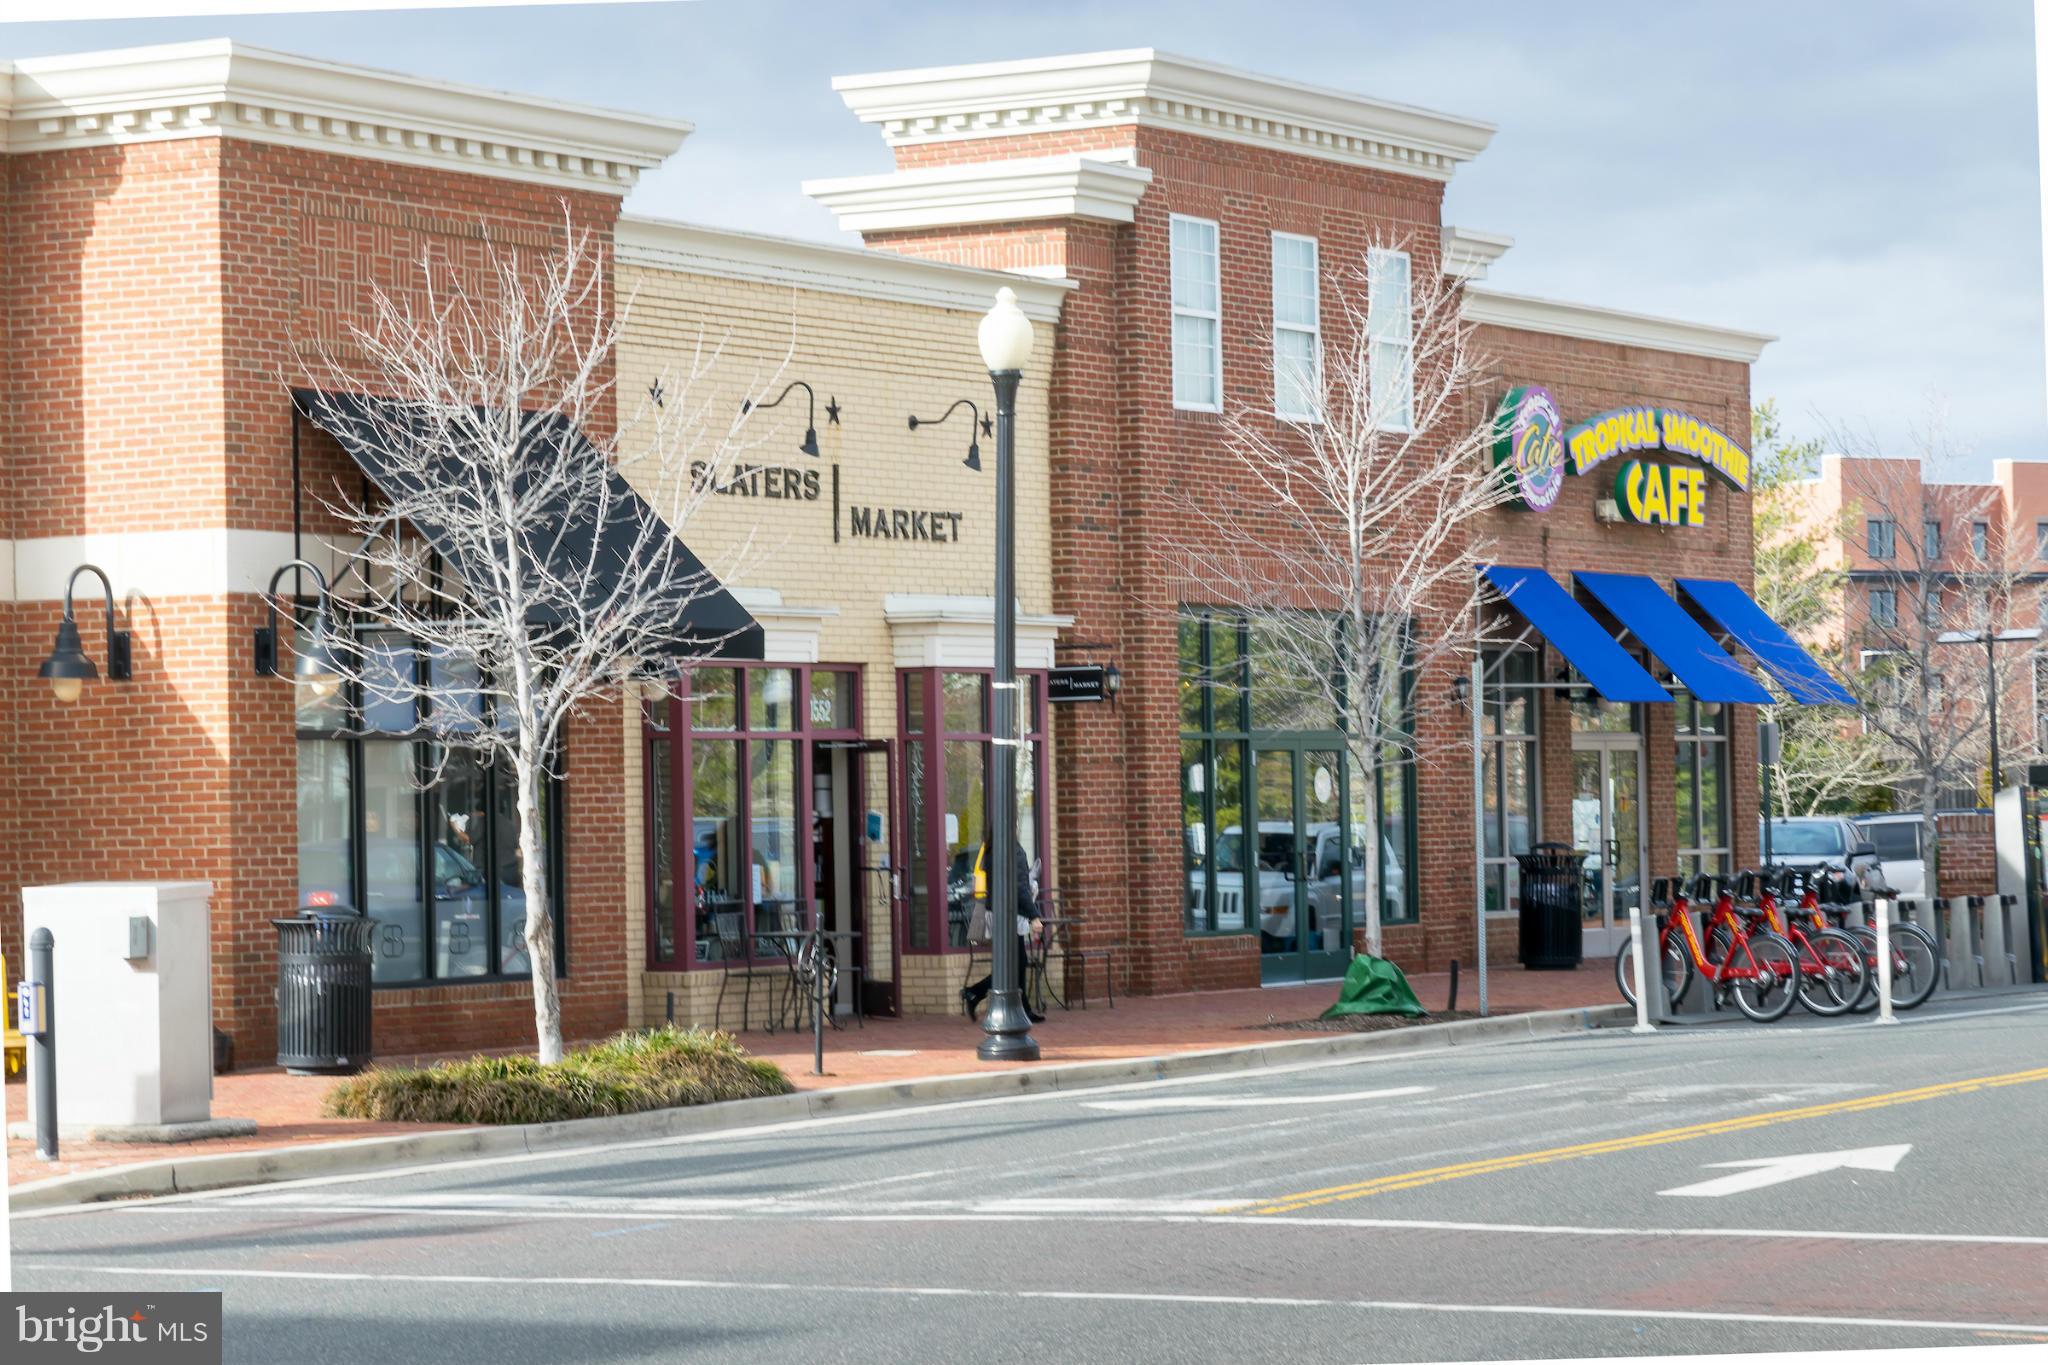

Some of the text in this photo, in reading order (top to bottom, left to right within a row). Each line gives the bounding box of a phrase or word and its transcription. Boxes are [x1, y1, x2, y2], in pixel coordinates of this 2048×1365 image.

[1570, 408, 1661, 473] TROPICAL
[1662, 412, 1750, 489] SMOOTHIE
[850, 506, 963, 543] MARKET
[1625, 461, 1707, 527] CAFE
